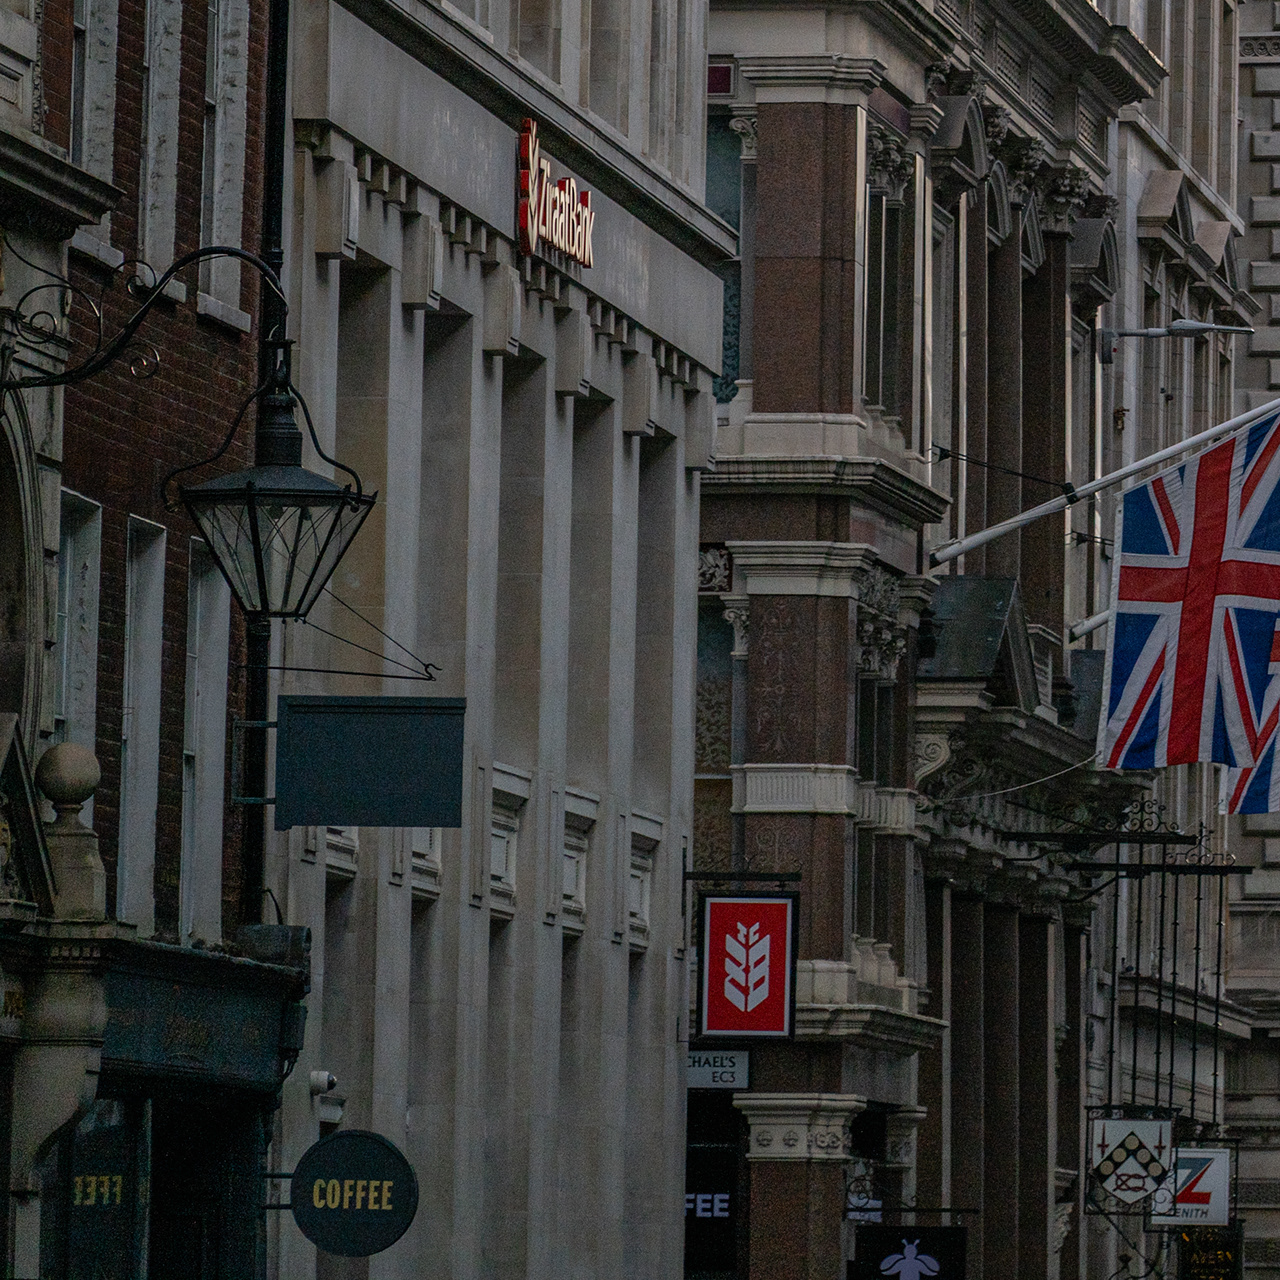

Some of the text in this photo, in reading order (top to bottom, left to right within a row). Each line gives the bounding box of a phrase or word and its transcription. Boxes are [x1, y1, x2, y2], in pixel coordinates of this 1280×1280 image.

[538, 157, 595, 268] ZiraatBank
[711, 1070, 736, 1083] EC3
[312, 1177, 394, 1211] COFFEE
